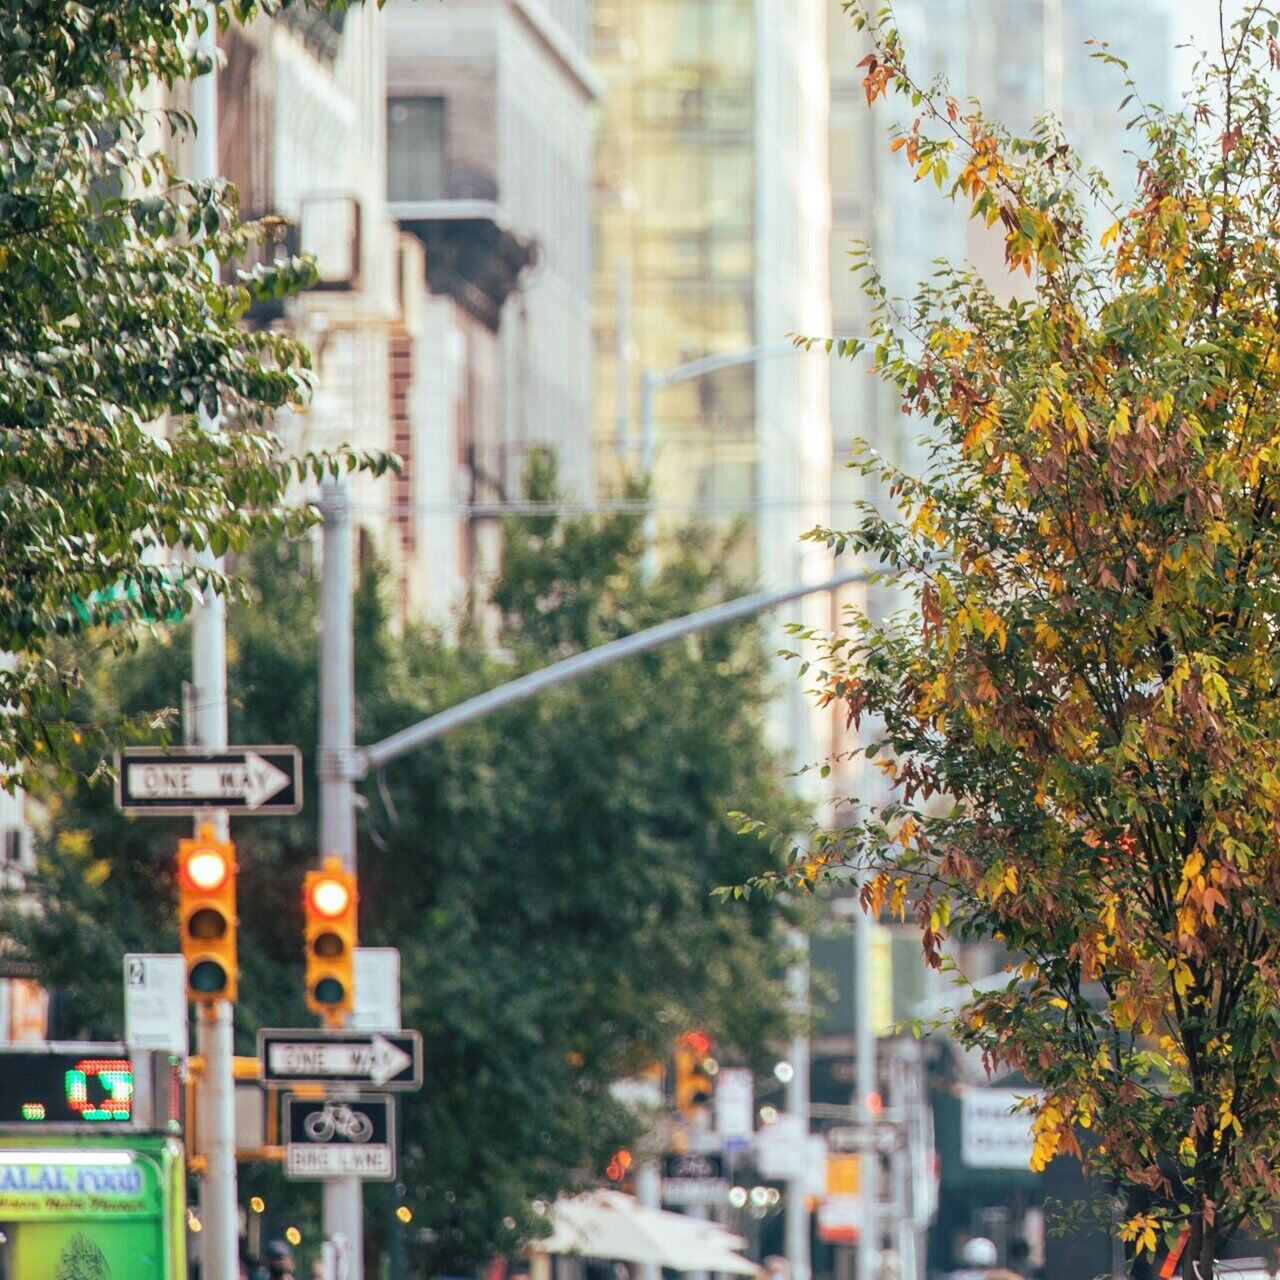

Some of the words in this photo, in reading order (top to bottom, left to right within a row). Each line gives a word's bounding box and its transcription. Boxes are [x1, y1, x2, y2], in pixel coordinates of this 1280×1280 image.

[143, 767, 194, 796] ONE
[217, 767, 272, 797] WAY
[283, 1045, 325, 1074] ONE
[348, 1046, 396, 1075] WAY
[293, 1146, 329, 1171] BIKE
[338, 1146, 386, 1172] LANE
